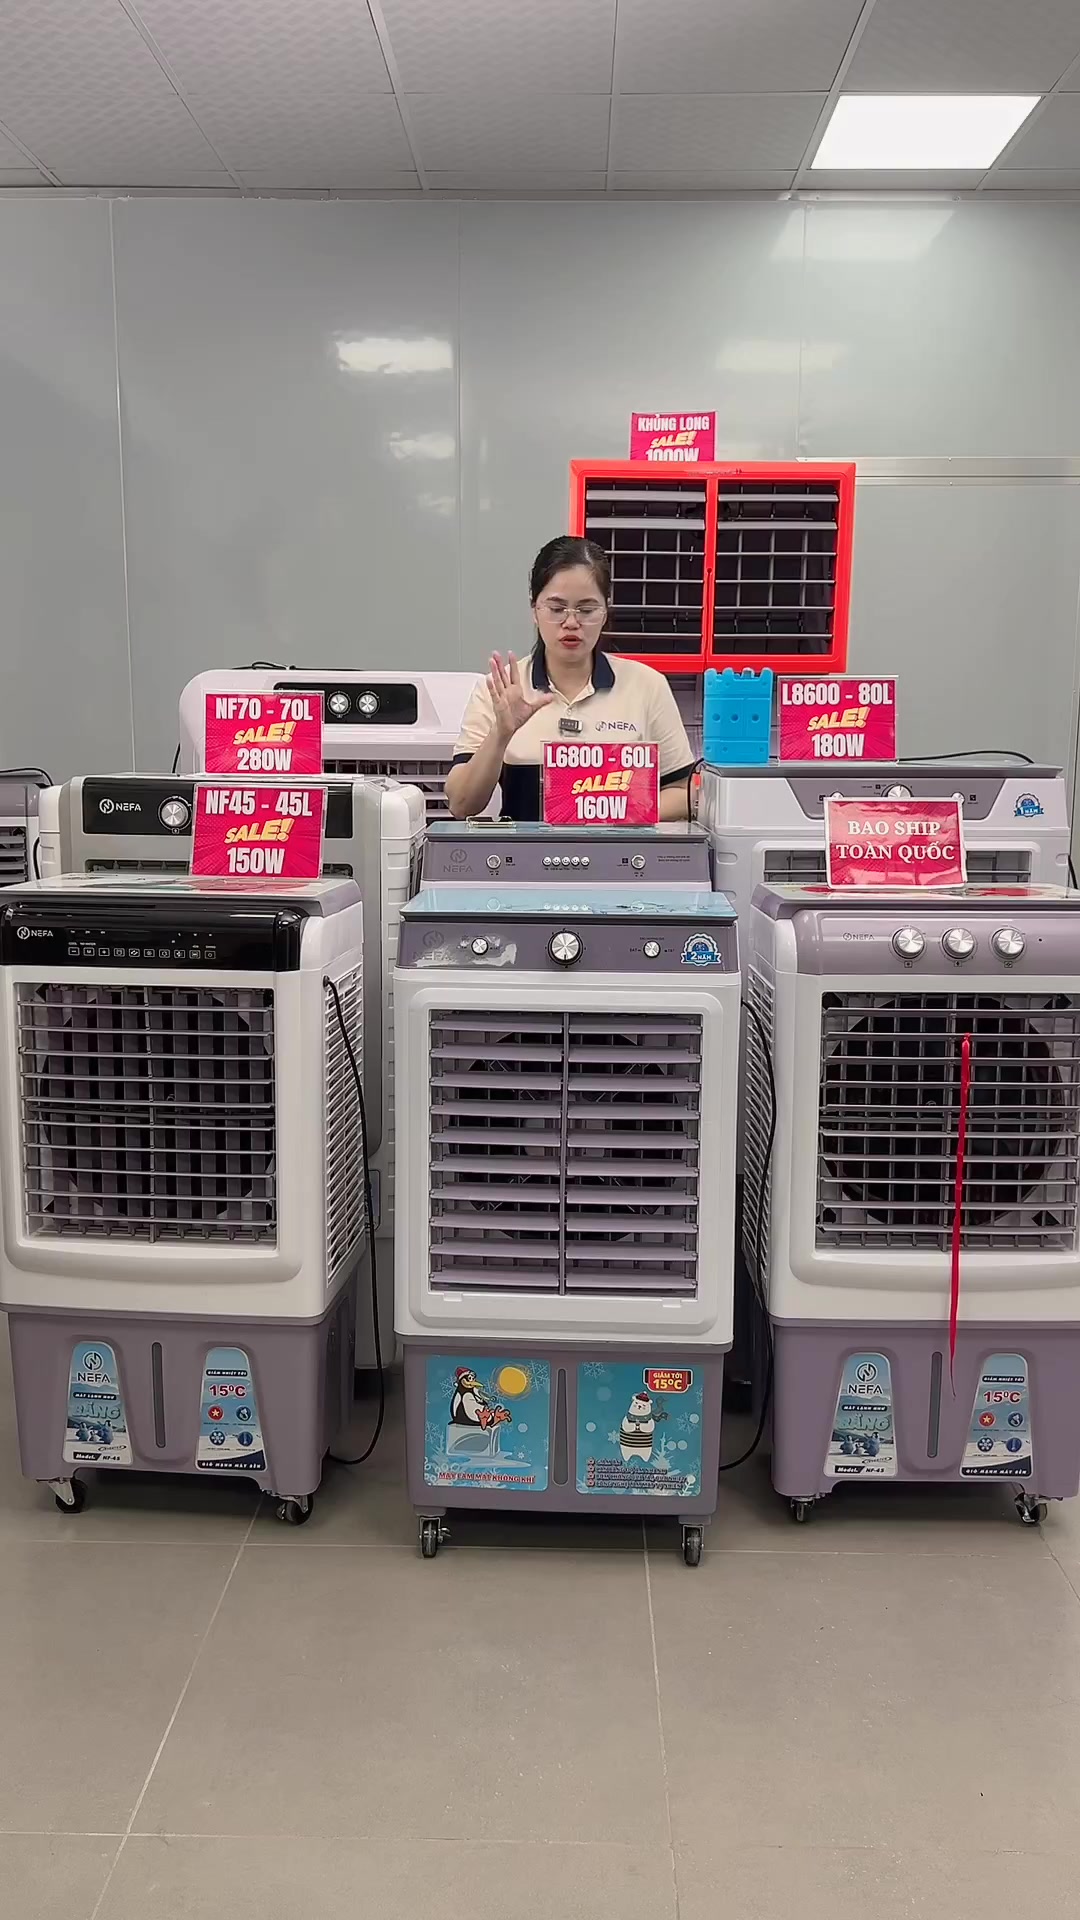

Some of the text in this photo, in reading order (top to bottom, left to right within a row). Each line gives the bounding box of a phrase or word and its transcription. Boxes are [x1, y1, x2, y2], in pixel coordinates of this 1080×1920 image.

[638, 413, 710, 431] KHỦNG LONG
[650, 431, 697, 448] SALE!
[645, 448, 699, 462] 1000W
[782, 683, 840, 705] L8600
[858, 683, 893, 705] 80L
[215, 698, 261, 720] NF70
[280, 699, 313, 720] 70L
[807, 706, 871, 731] SALE!
[233, 721, 297, 745] SALE!
[608, 722, 637, 732] NEFA
[811, 733, 865, 757] 180W
[237, 748, 293, 771] 280W
[546, 745, 604, 768] L6800
[621, 746, 655, 768] 60L
[571, 770, 634, 795] SALE!
[116, 803, 142, 811] NEFA
[205, 790, 256, 815] NF45
[275, 791, 313, 816] 45L
[575, 796, 628, 820] 160W
[224, 818, 295, 844] SALE!
[847, 821, 941, 836] BAO SHIP
[227, 847, 285, 874] 150W
[836, 841, 955, 863] TOÀN QUỐC
[443, 865, 473, 873] NEFA
[690, 952, 698, 960] 2
[77, 1372, 111, 1383] NEFA
[848, 1384, 883, 1394] NEFA
